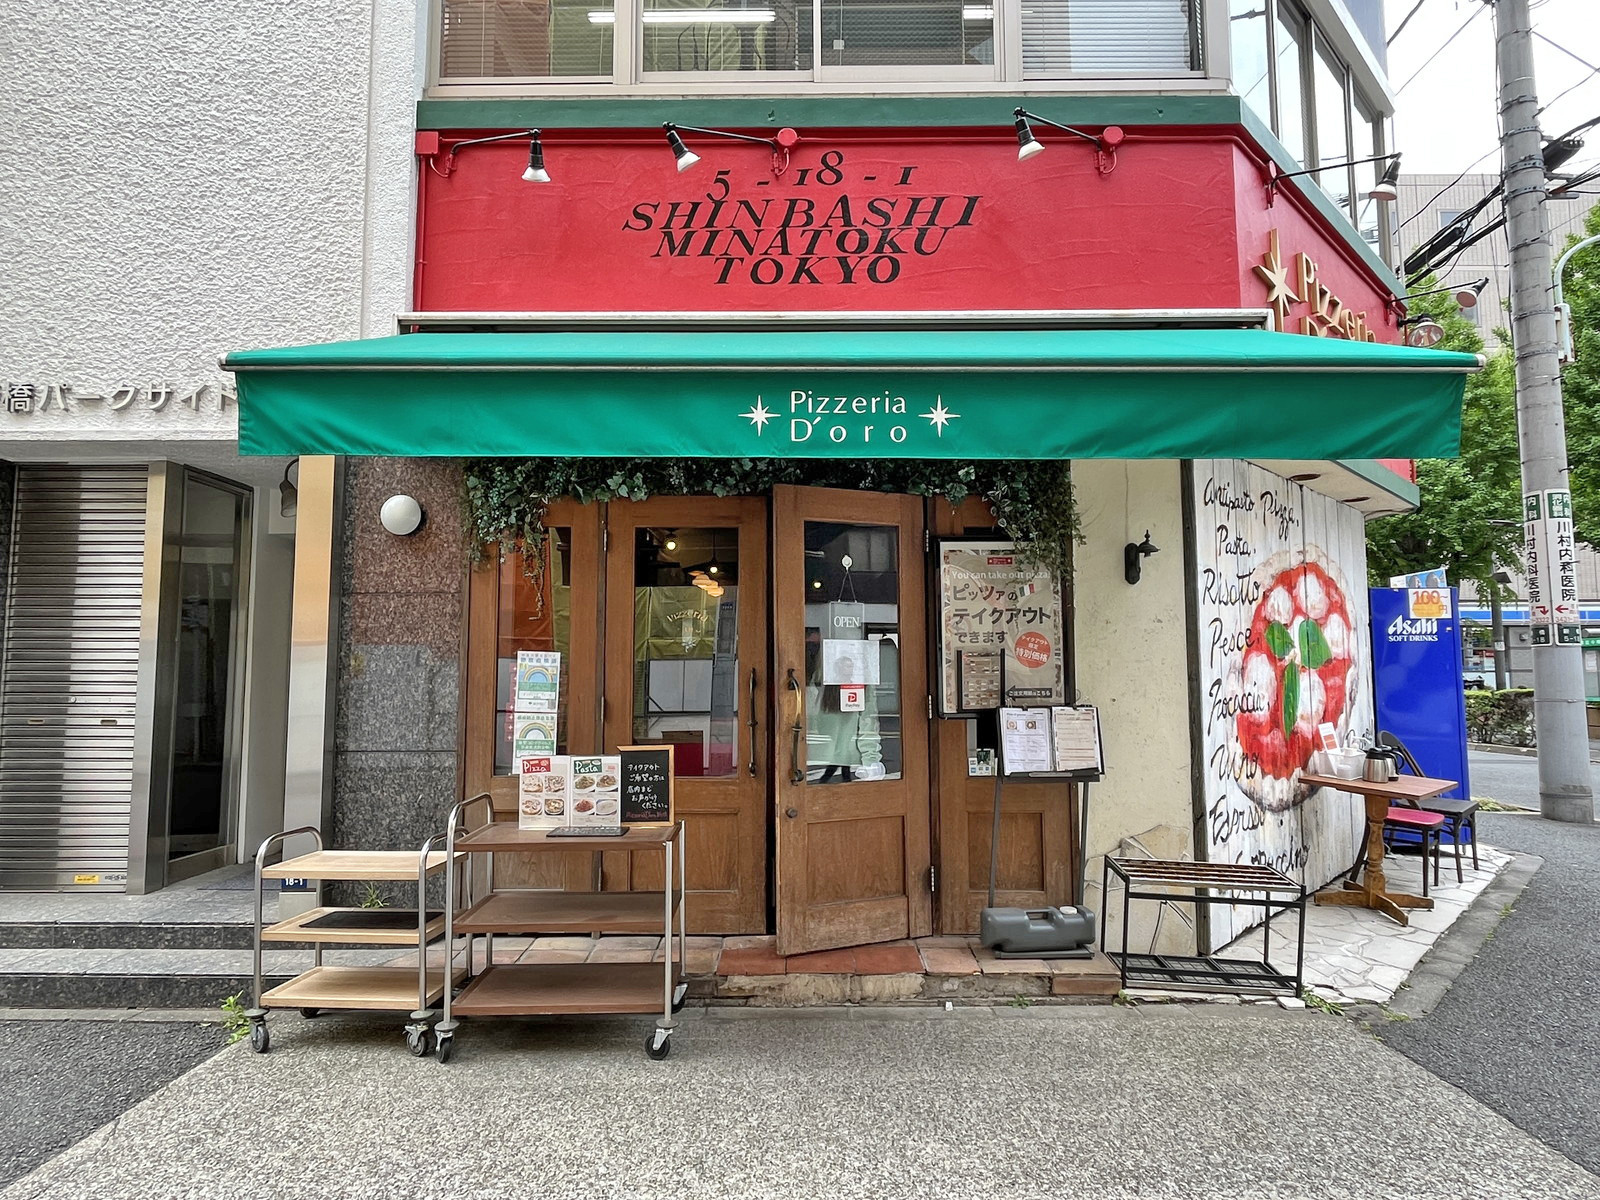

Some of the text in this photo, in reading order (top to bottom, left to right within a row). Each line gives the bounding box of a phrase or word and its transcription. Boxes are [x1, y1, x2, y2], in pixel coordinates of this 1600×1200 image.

[706, 170, 731, 201] 5
[793, 150, 844, 186] 18
[622, 194, 984, 231] SHINBASHI
[651, 226, 953, 258] MINATOKU
[713, 255, 901, 285] TOKYO
[790, 390, 907, 414] Pizzeria
[1557, 521, 1576, 602] 川村内科医院
[951, 571, 968, 579] You
[988, 571, 1008, 579] take
[953, 583, 1017, 601] ピッツァの
[833, 615, 860, 628] OPEN
[953, 607, 1051, 625] テイクアウト
[1388, 614, 1438, 635] Asahi
[955, 631, 1008, 644] できます
[1016, 647, 1048, 663] 特別価格
[522, 760, 547, 773] Pizza
[574, 760, 598, 773] Pasta
[627, 764, 660, 772] テイクアウト
[285, 878, 303, 886] 18-1
